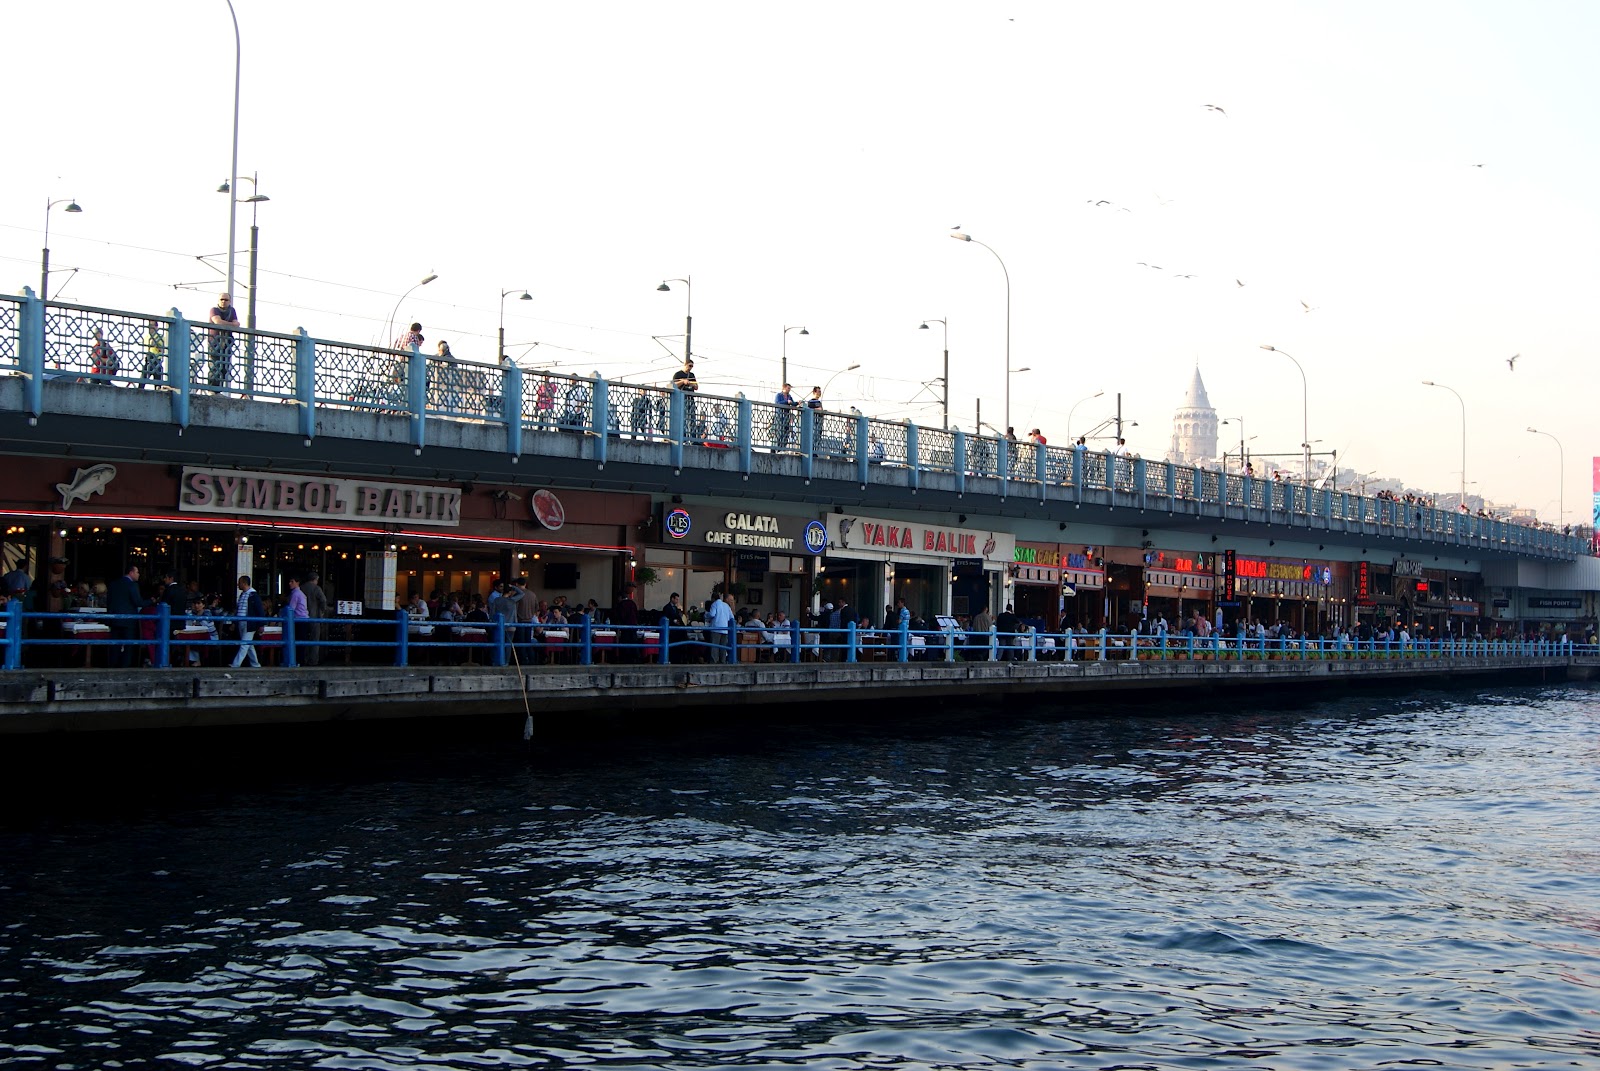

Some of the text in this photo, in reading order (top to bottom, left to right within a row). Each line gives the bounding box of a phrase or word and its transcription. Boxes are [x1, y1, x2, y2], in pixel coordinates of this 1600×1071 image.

[187, 473, 460, 520] SYMBOL BALIK
[725, 512, 779, 533] GALATA
[706, 531, 794, 550] CAFE RESTAURANT
[863, 522, 976, 555] YAKA BALIK
[1014, 546, 1036, 563] STAR
[1037, 549, 1059, 567] CAFE
